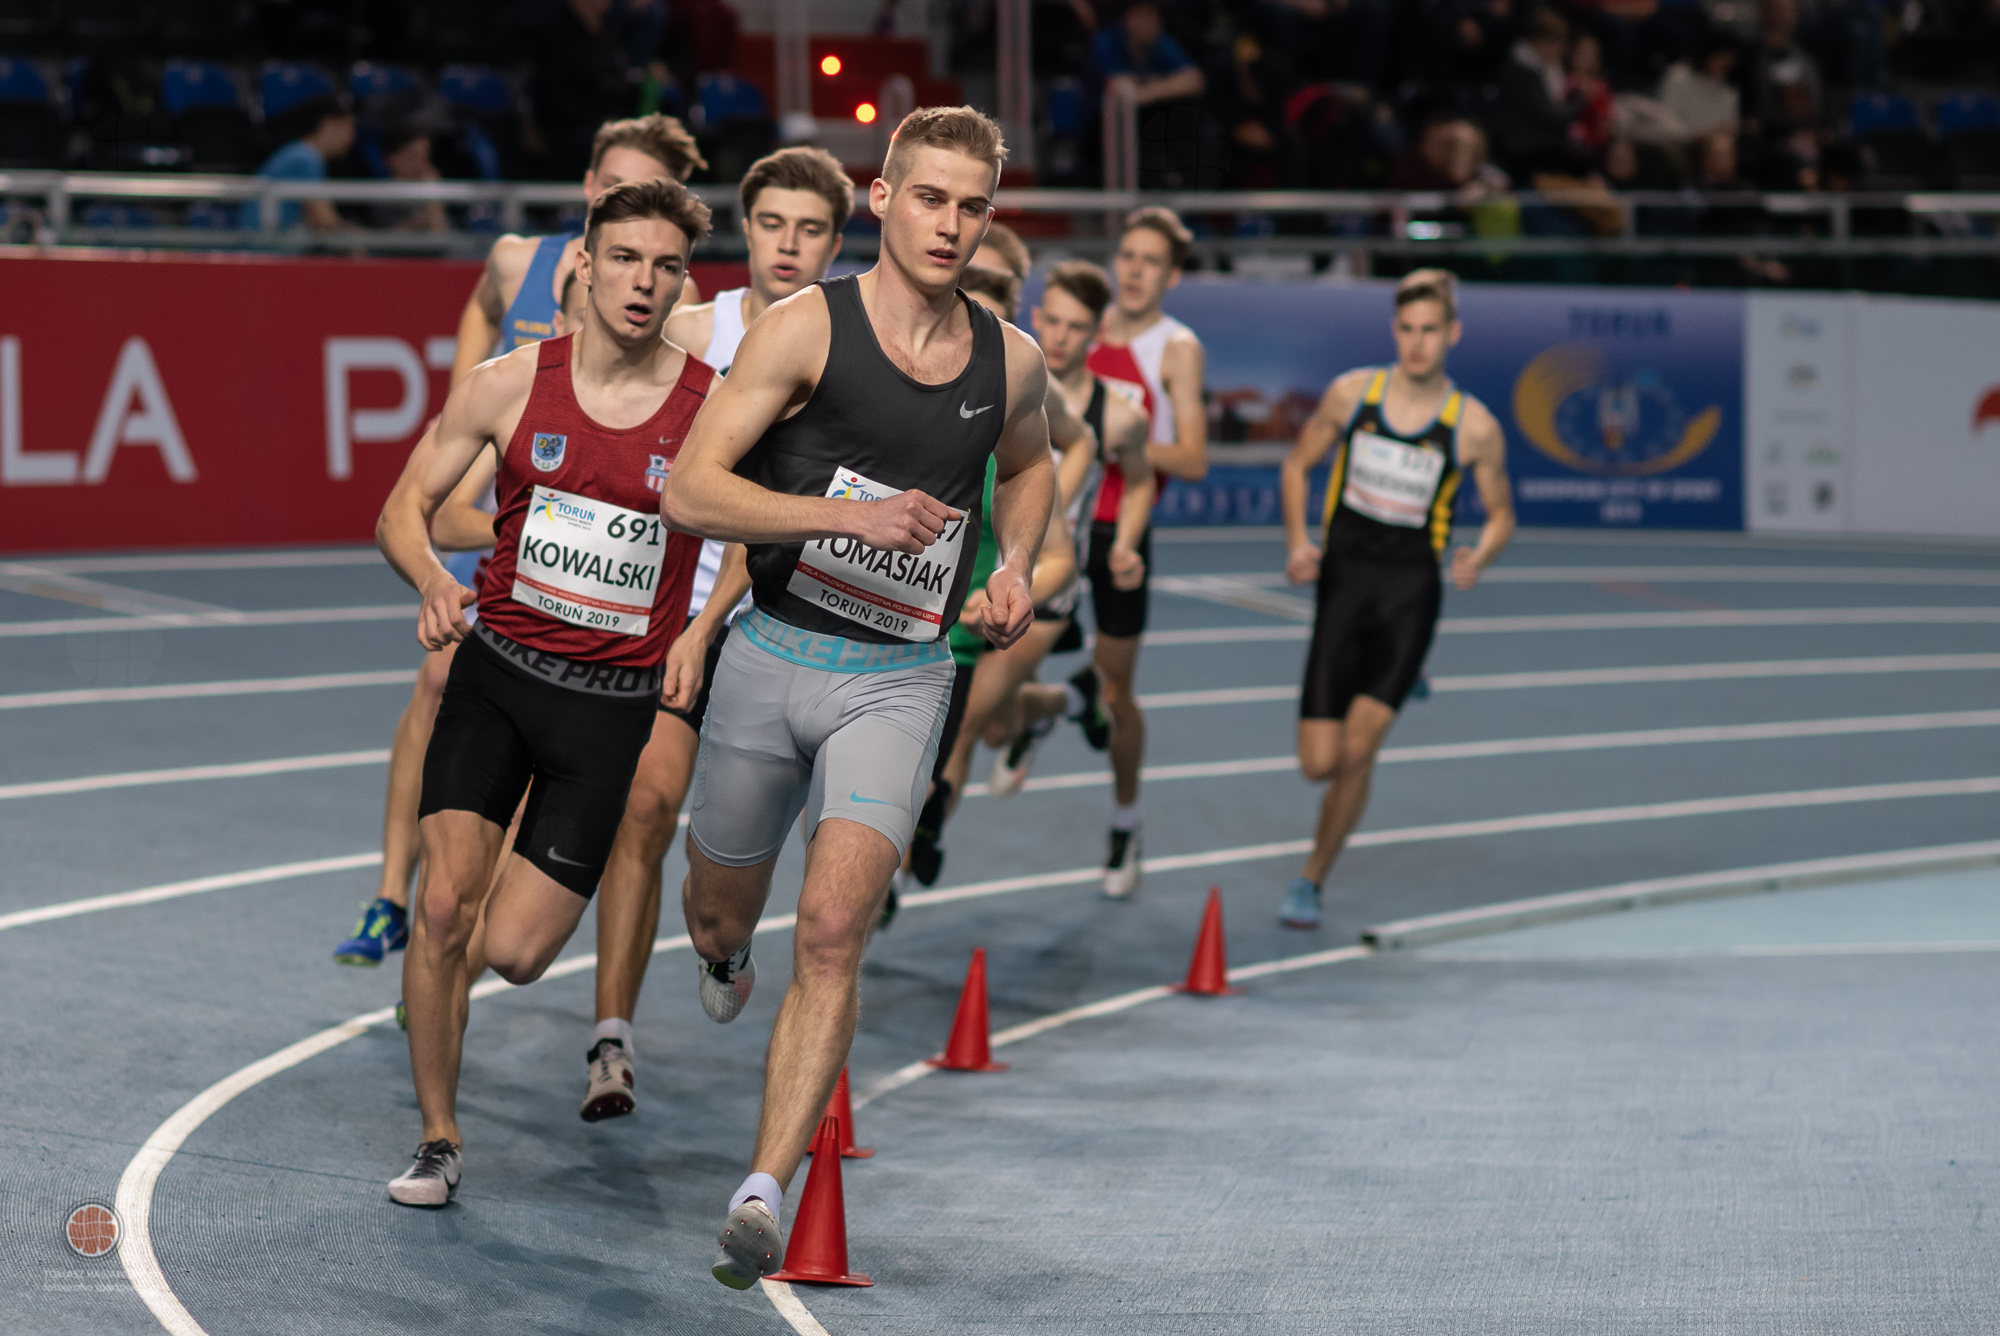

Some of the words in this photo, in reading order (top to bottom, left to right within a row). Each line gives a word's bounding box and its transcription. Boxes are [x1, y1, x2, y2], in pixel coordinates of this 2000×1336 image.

[559, 502, 596, 522] TORUŃ
[607, 513, 660, 546] 691
[523, 535, 656, 591] KOWALSKI
[802, 565, 818, 577] PZLA
[819, 574, 846, 589] HALOWE
[846, 587, 891, 607] MISTRZOSTWA
[892, 603, 912, 613] POLSKI
[539, 595, 583, 621] TORUŃ
[586, 611, 620, 628] 2019
[820, 589, 873, 621] TORUŃ
[873, 612, 909, 633] 2019
[559, 659, 643, 692] PRO
